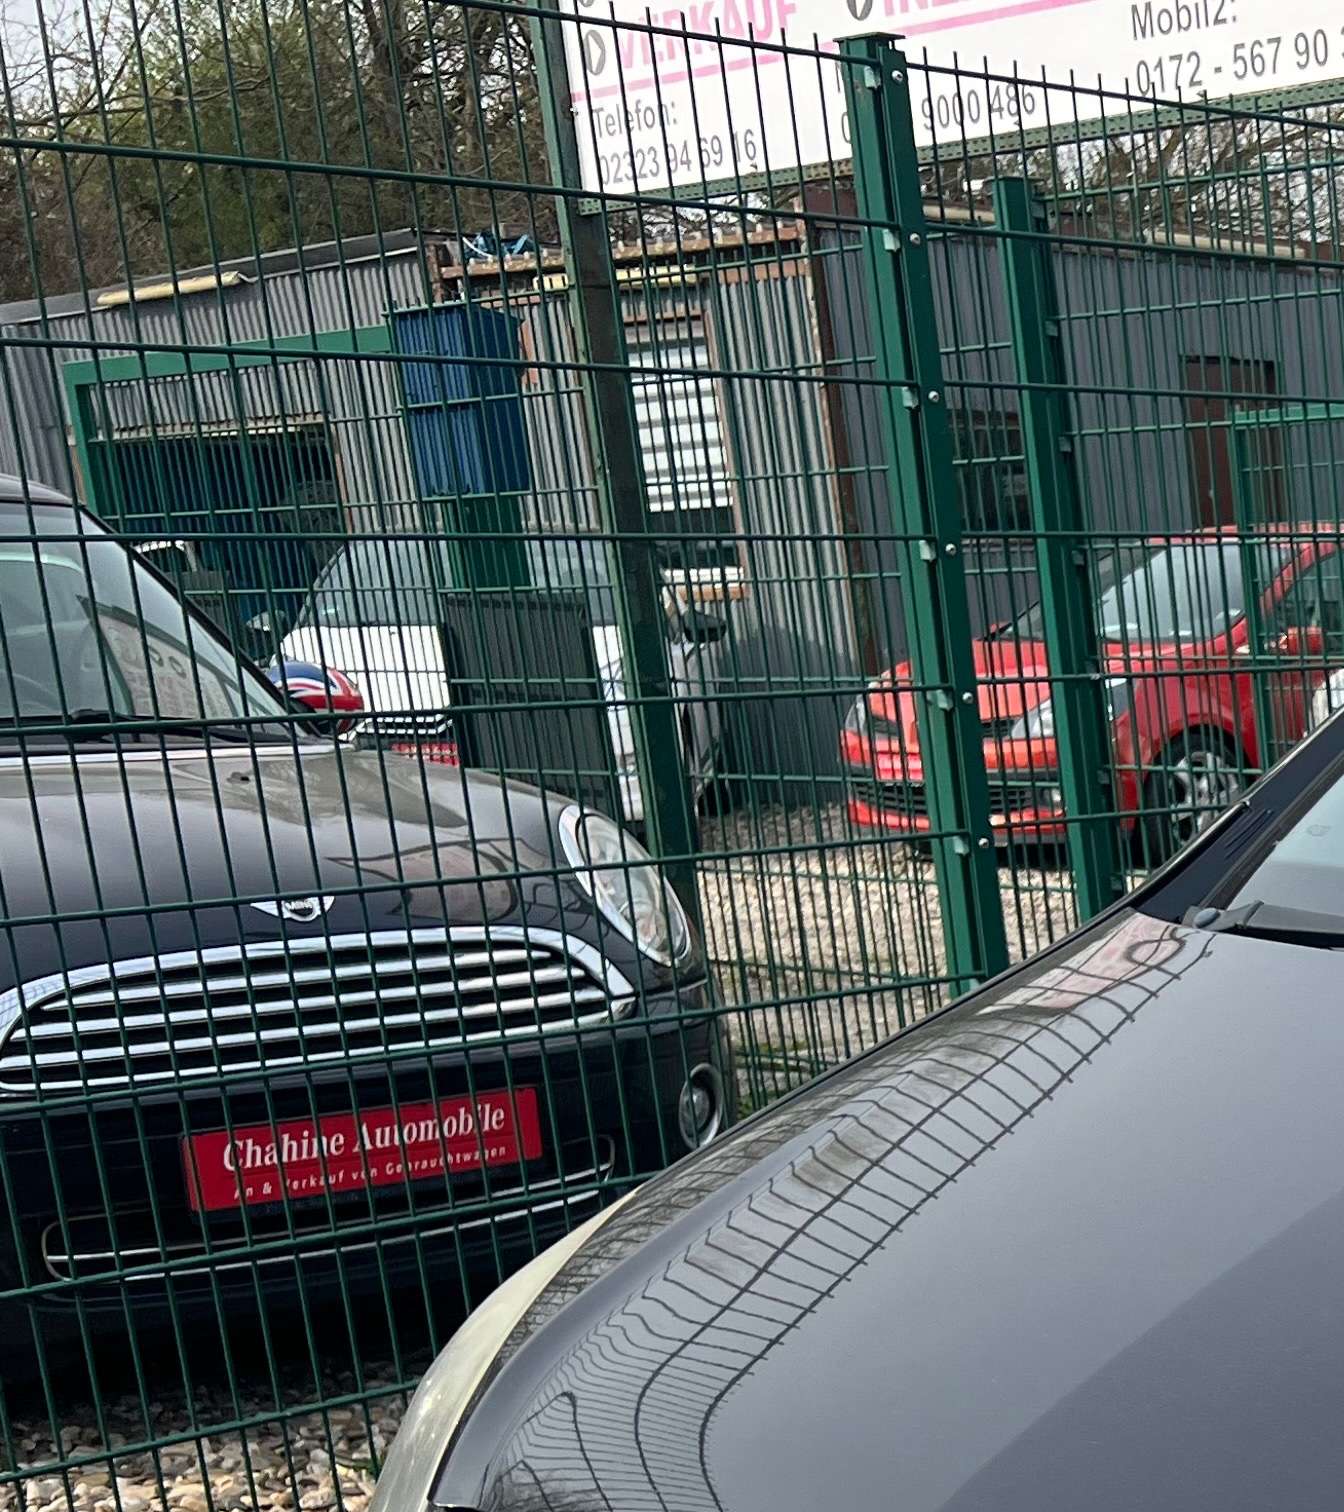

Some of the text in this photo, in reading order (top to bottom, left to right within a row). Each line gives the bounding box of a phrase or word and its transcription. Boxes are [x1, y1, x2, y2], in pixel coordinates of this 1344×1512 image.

[1136, 51, 1203, 97] 0172
[1232, 36, 1282, 81] 567
[1294, 29, 1329, 70] 90
[592, 98, 678, 139] Telefon:
[990, 80, 1036, 121] 486
[598, 128, 757, 186] 02323 94 69 16
[223, 1129, 346, 1172] Chahine
[281, 1169, 345, 1191] erkauf
